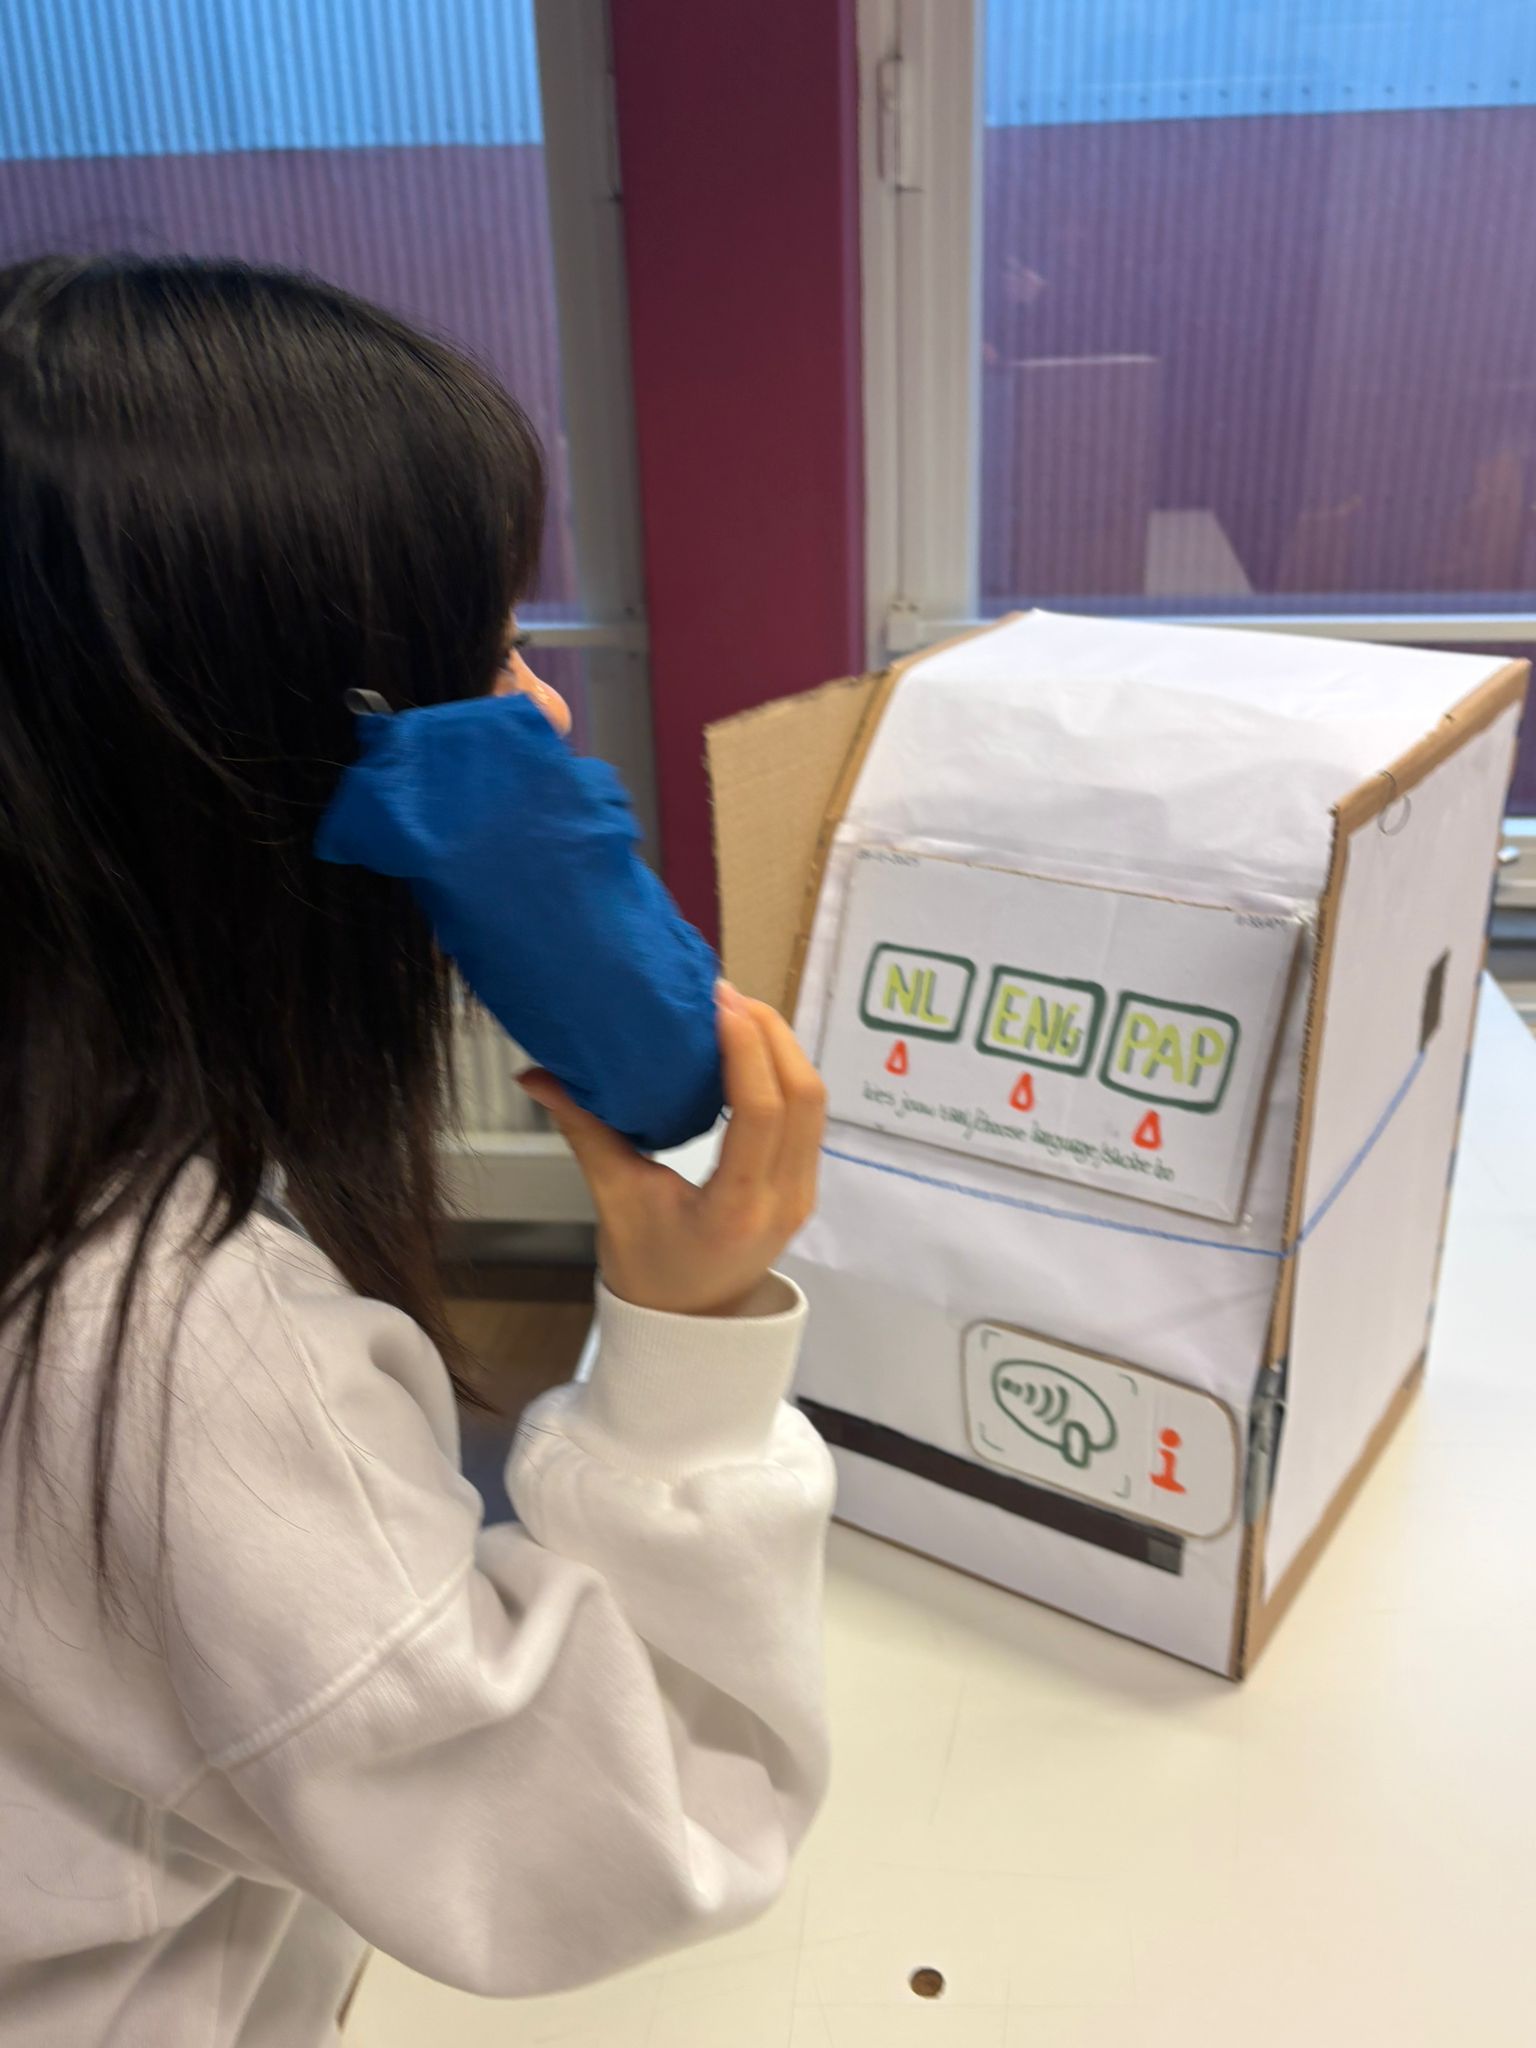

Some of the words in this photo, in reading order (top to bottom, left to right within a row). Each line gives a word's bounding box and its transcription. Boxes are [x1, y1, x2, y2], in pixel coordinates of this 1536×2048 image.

[882, 963, 949, 1025] NL
[991, 984, 1083, 1057] ENG
[1116, 1011, 1225, 1087] PAP
[1149, 1427, 1186, 1494] i
